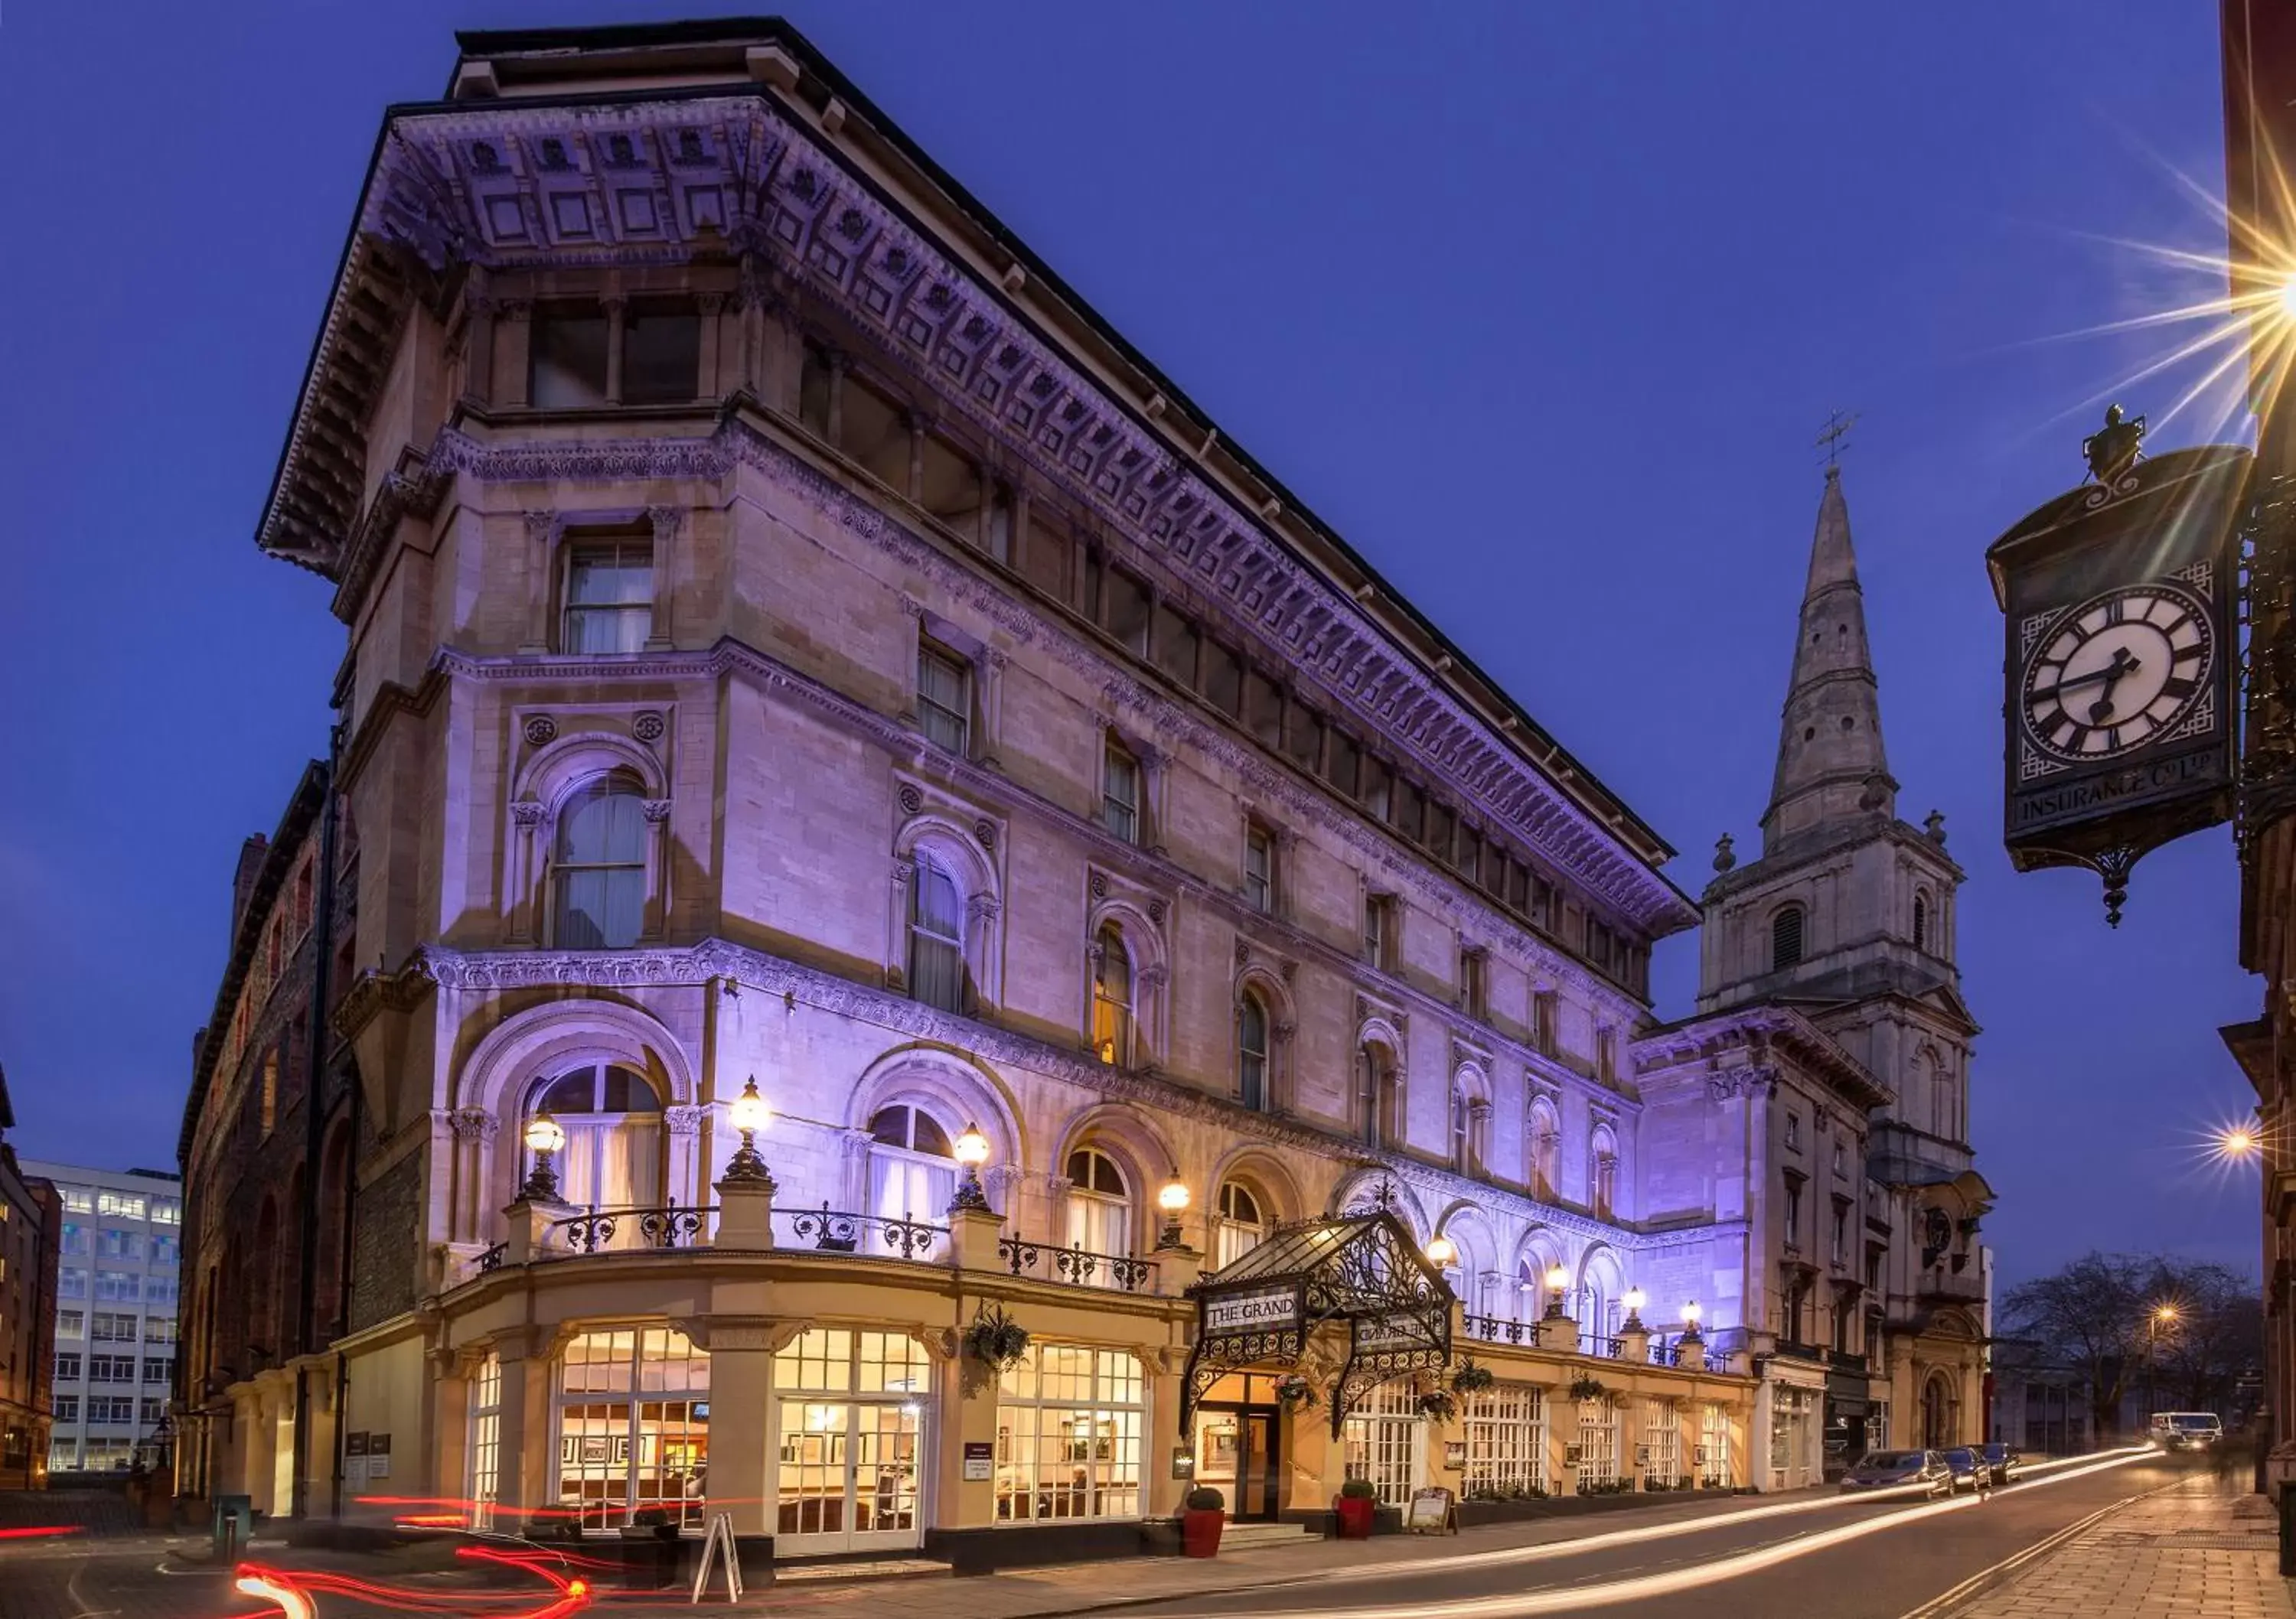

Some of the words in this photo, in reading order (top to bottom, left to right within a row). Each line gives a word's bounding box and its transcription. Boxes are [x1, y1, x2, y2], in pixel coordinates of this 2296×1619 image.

[2023, 774, 2144, 821] INSURANCE
[1208, 1306, 1239, 1327] THE
[1242, 1298, 1294, 1318] GRAND
